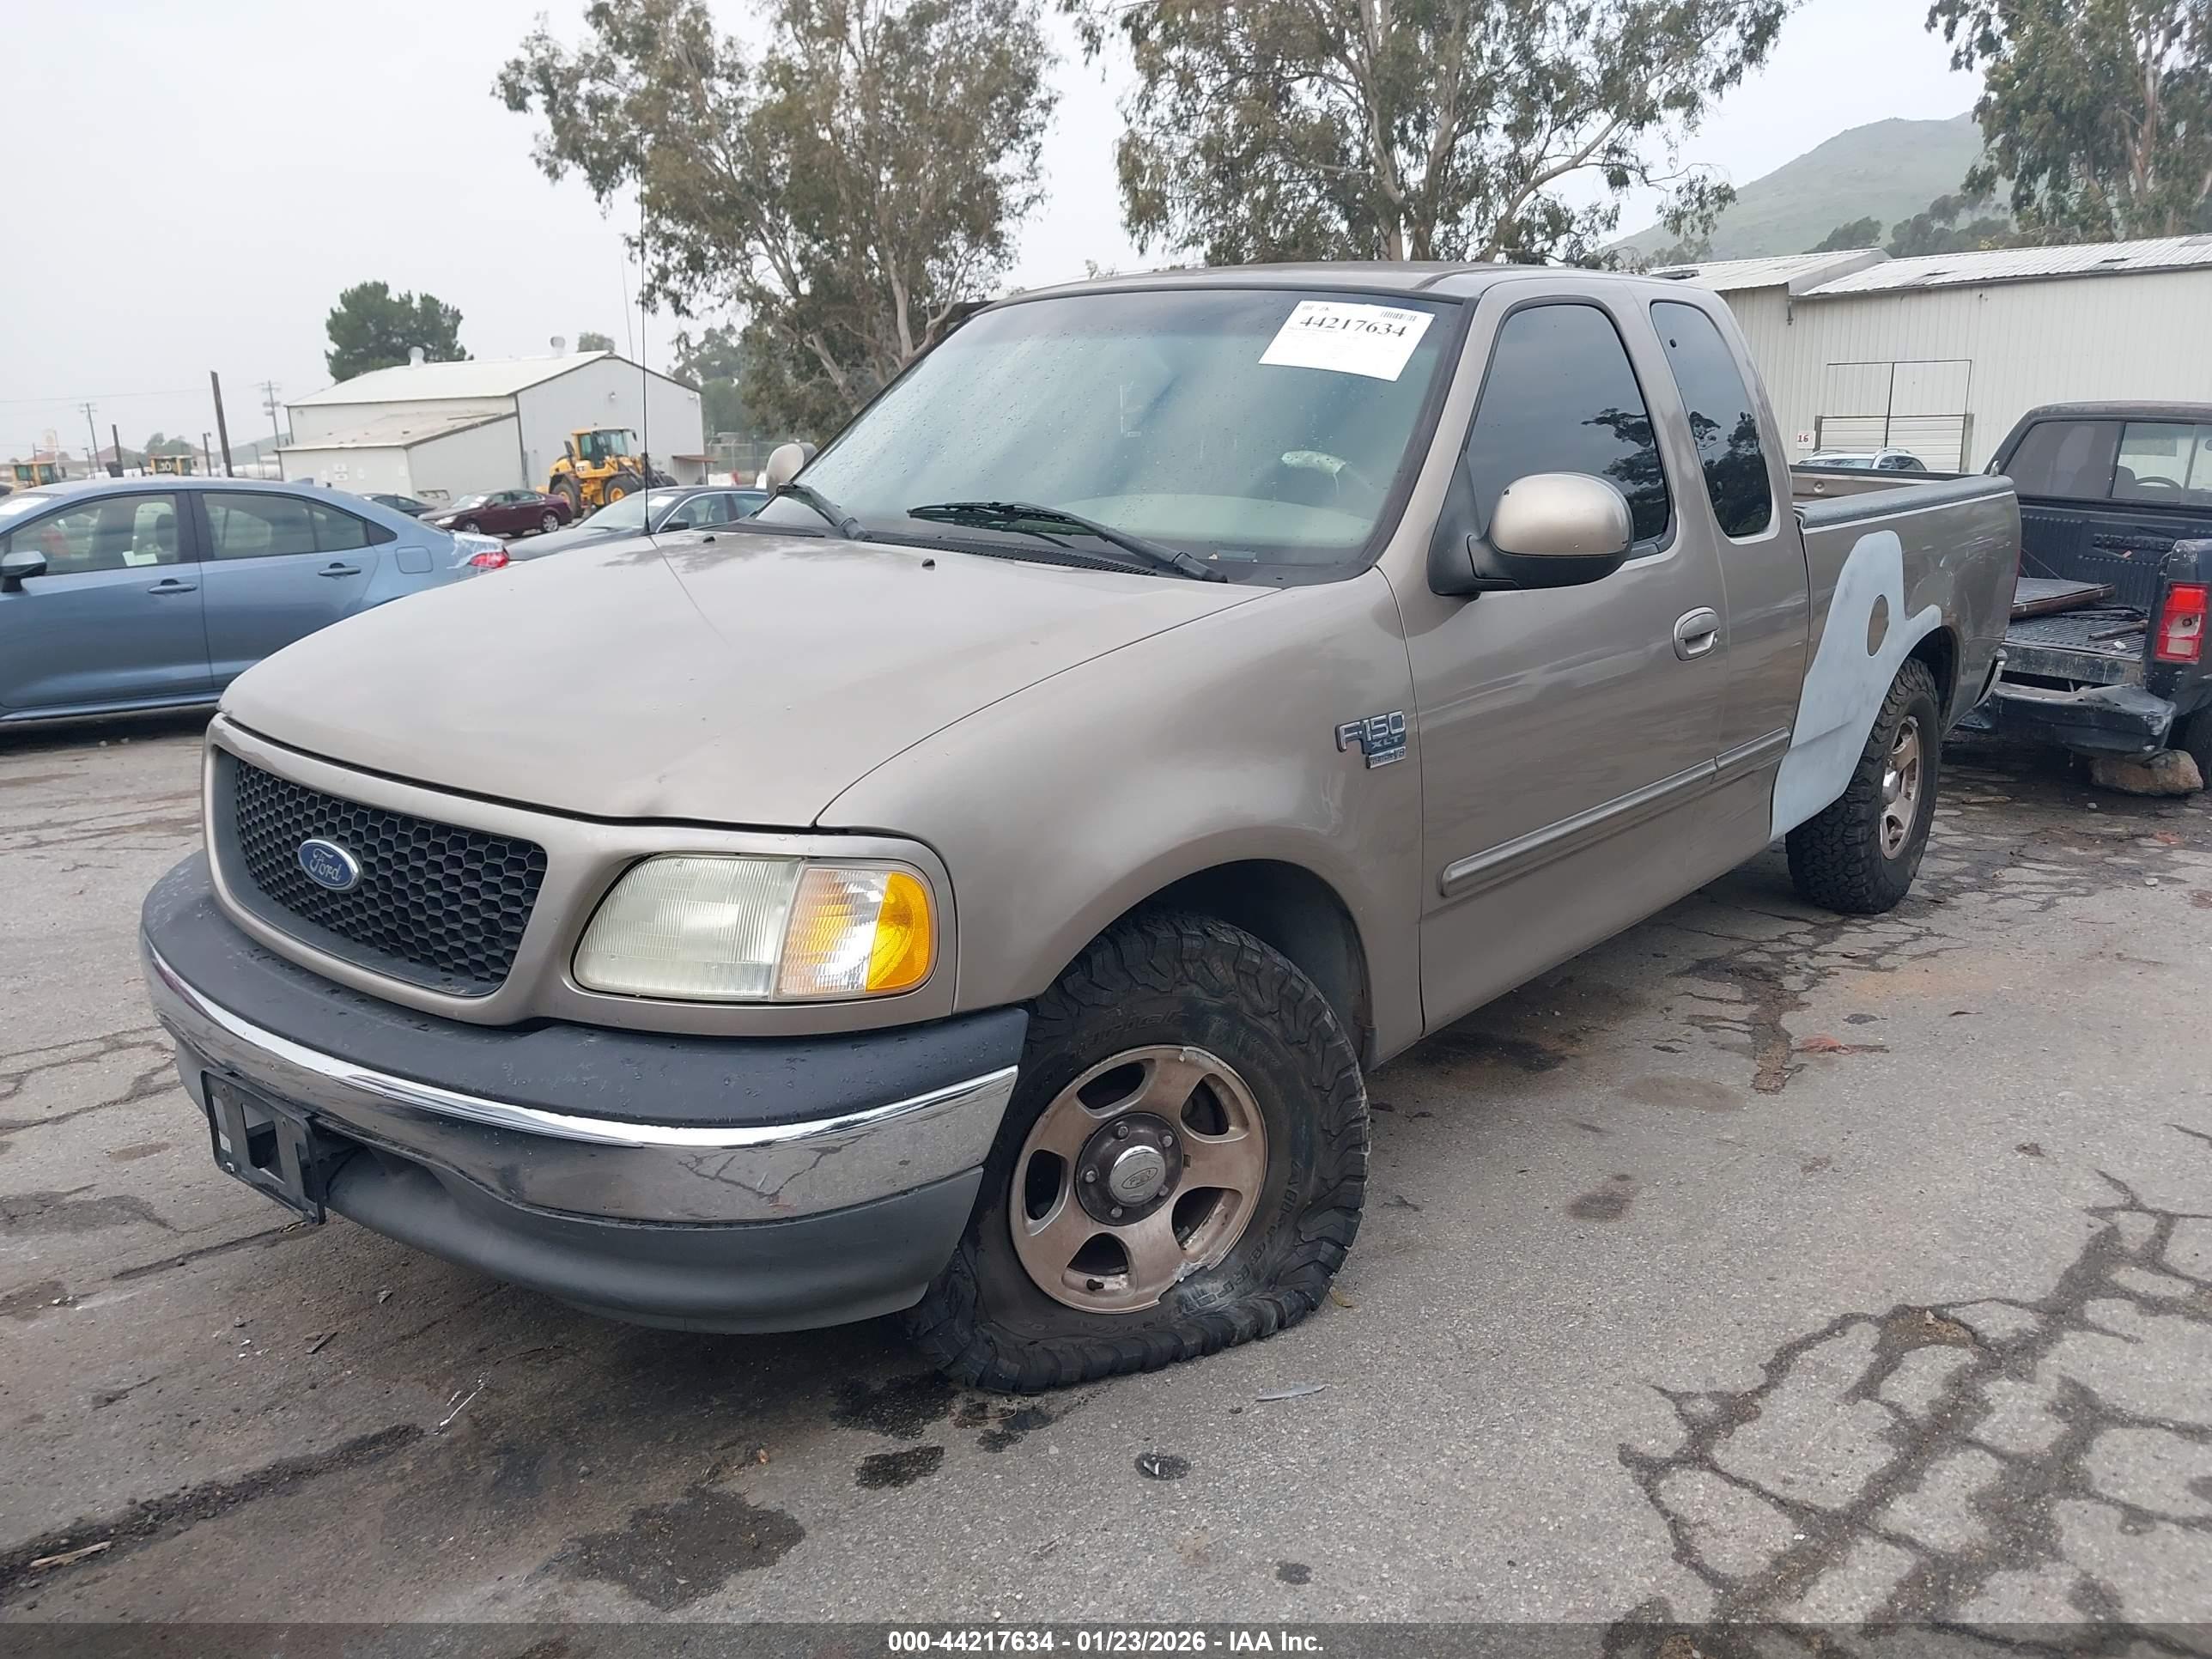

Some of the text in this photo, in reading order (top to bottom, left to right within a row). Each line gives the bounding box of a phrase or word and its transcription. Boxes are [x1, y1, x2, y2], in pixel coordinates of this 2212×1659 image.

[1300, 315, 1407, 337] 44217634
[1796, 434, 1809, 443] 16
[1371, 734, 1402, 750] XLT
[310, 848, 343, 882] Ford
